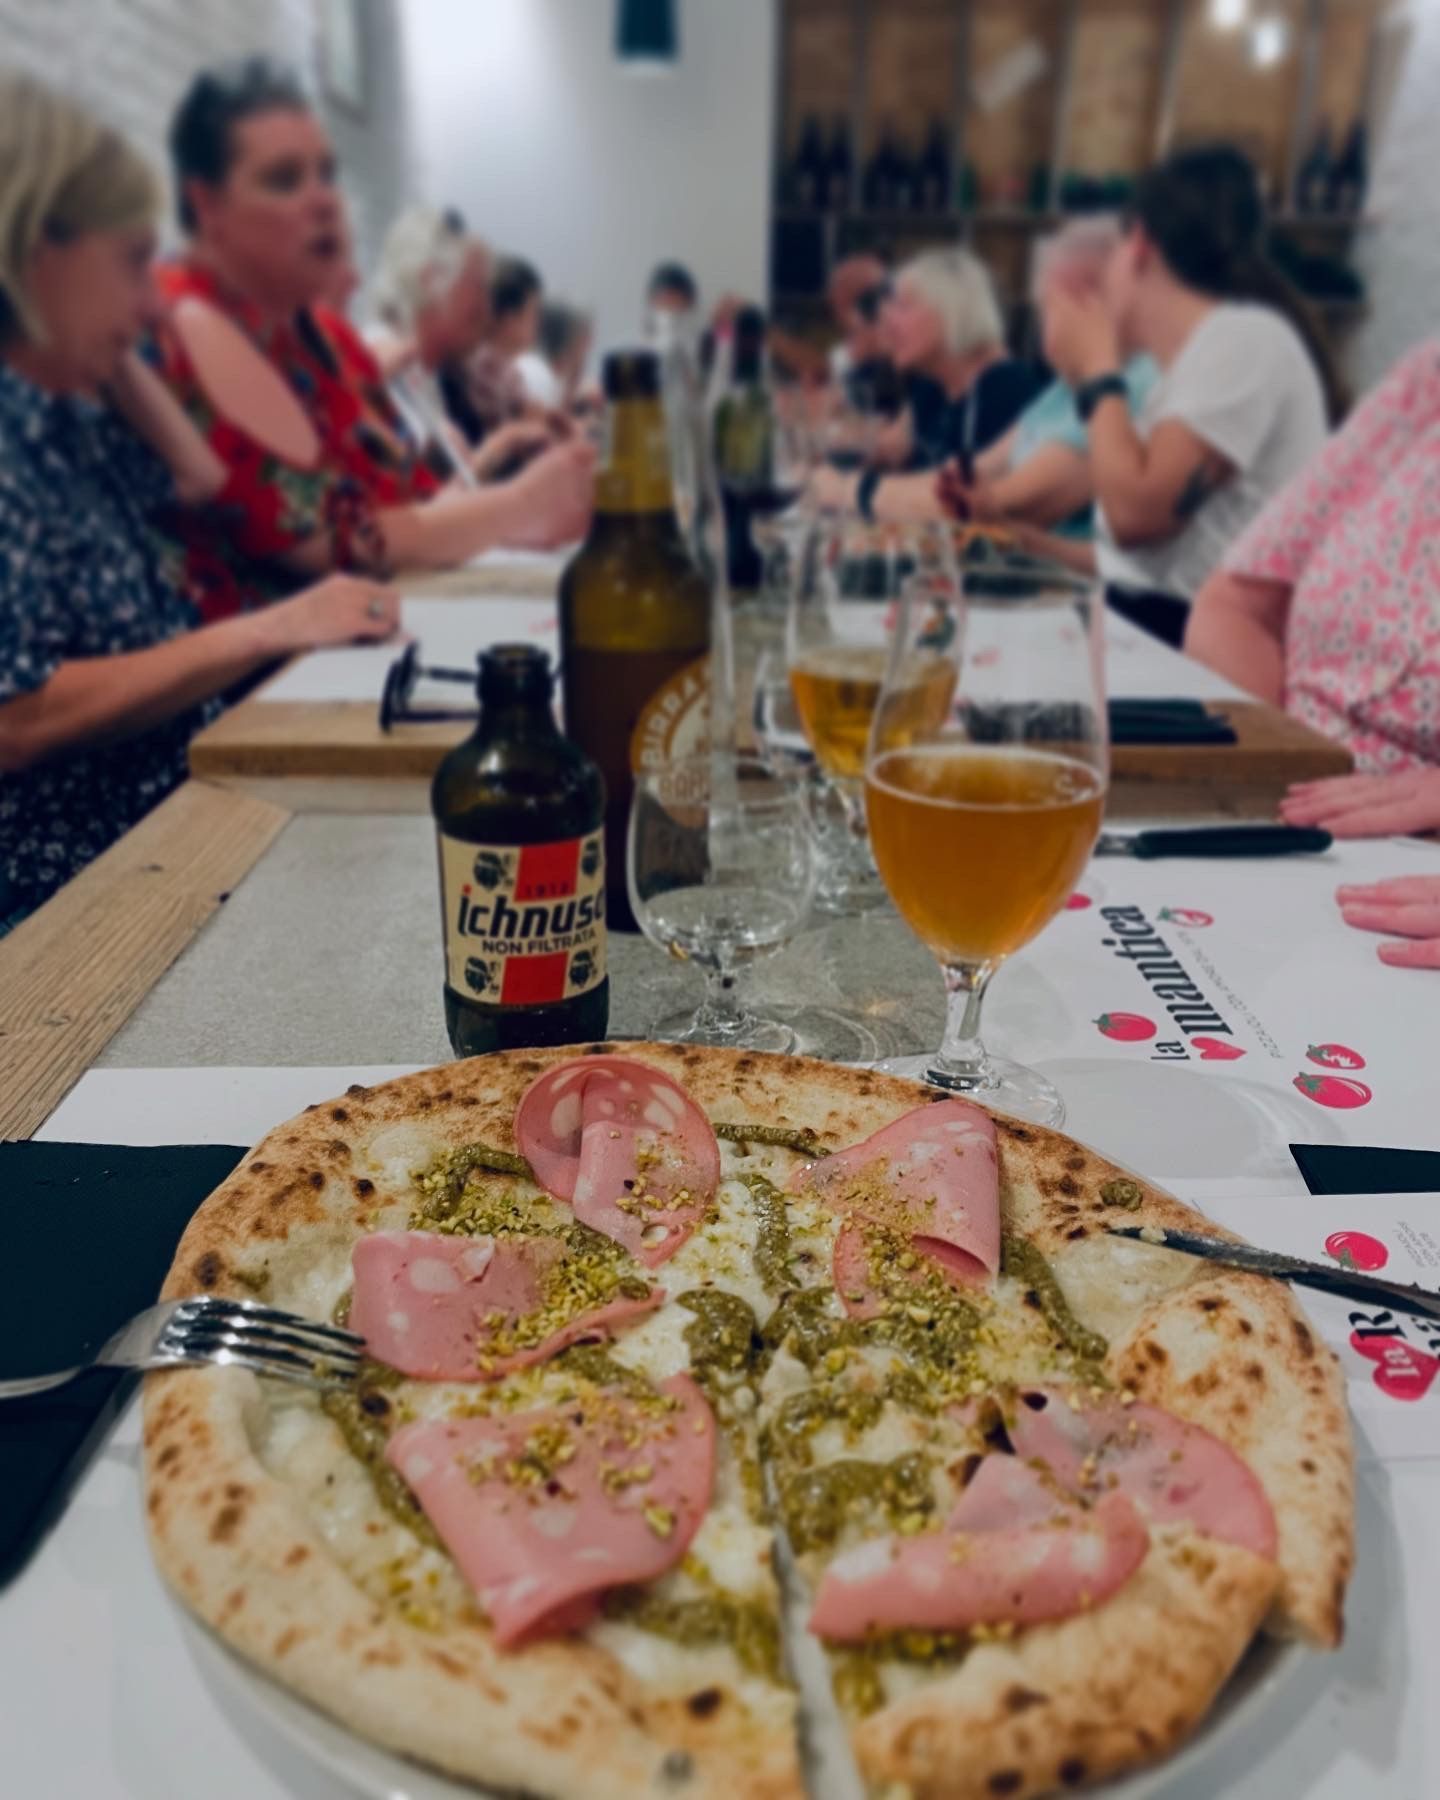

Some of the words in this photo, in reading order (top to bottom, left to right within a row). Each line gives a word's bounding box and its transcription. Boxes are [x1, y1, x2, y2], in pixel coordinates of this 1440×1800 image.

[482, 939, 522, 953] NON
[527, 929, 597, 952] FILTRATA
[1099, 905, 1233, 1035] mantica
[1150, 1040, 1191, 1060] la
[1383, 1346, 1422, 1377] la
